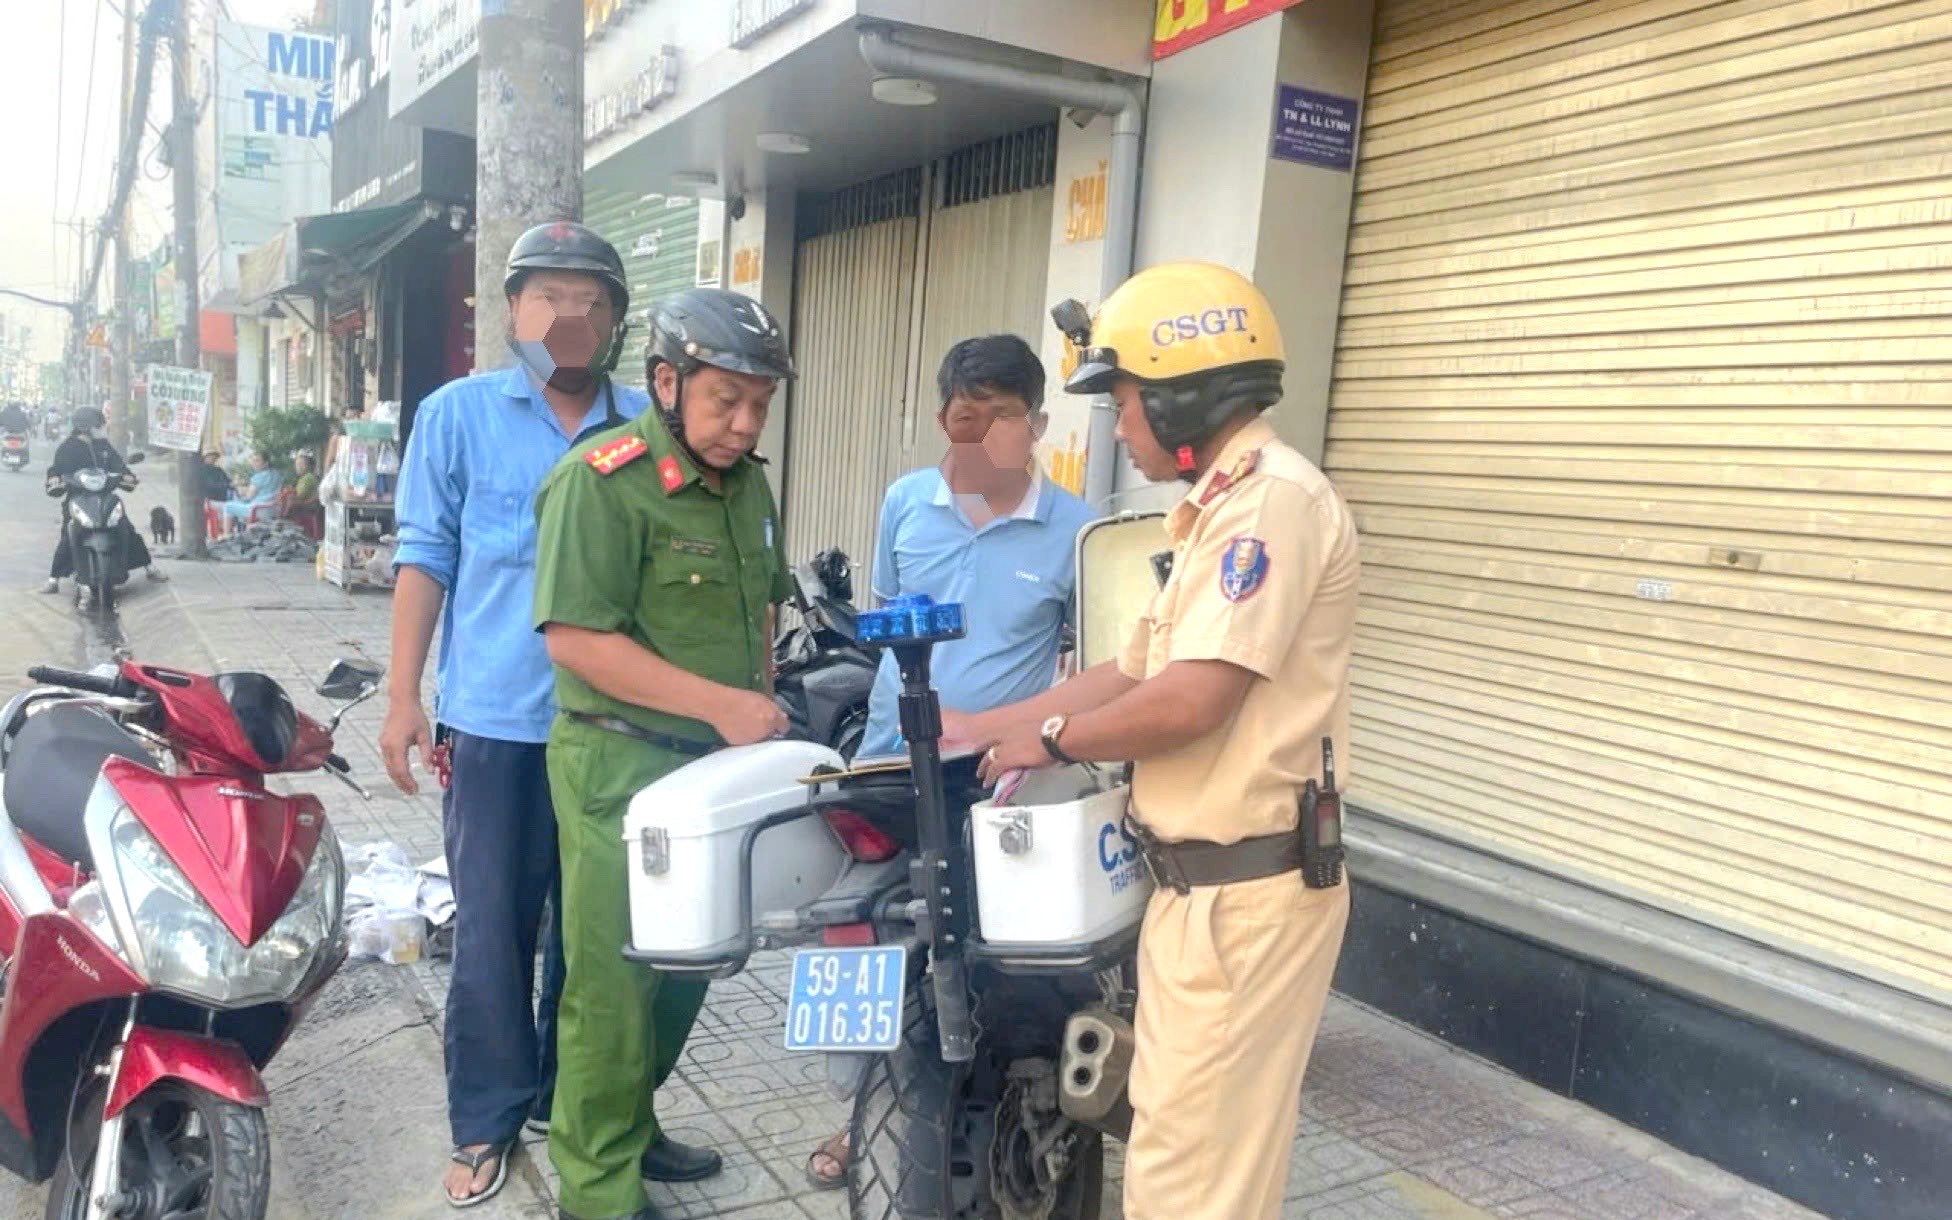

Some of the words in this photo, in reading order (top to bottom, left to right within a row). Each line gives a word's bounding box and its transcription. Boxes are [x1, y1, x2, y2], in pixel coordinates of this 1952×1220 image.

[1283, 107, 1298, 121] TN
[1300, 112, 1308, 123] &
[1151, 306, 1249, 347] CSGT
[57, 934, 100, 982] HONDA
[806, 953, 888, 997] 59-A1
[794, 1000, 894, 1043] 016.35
